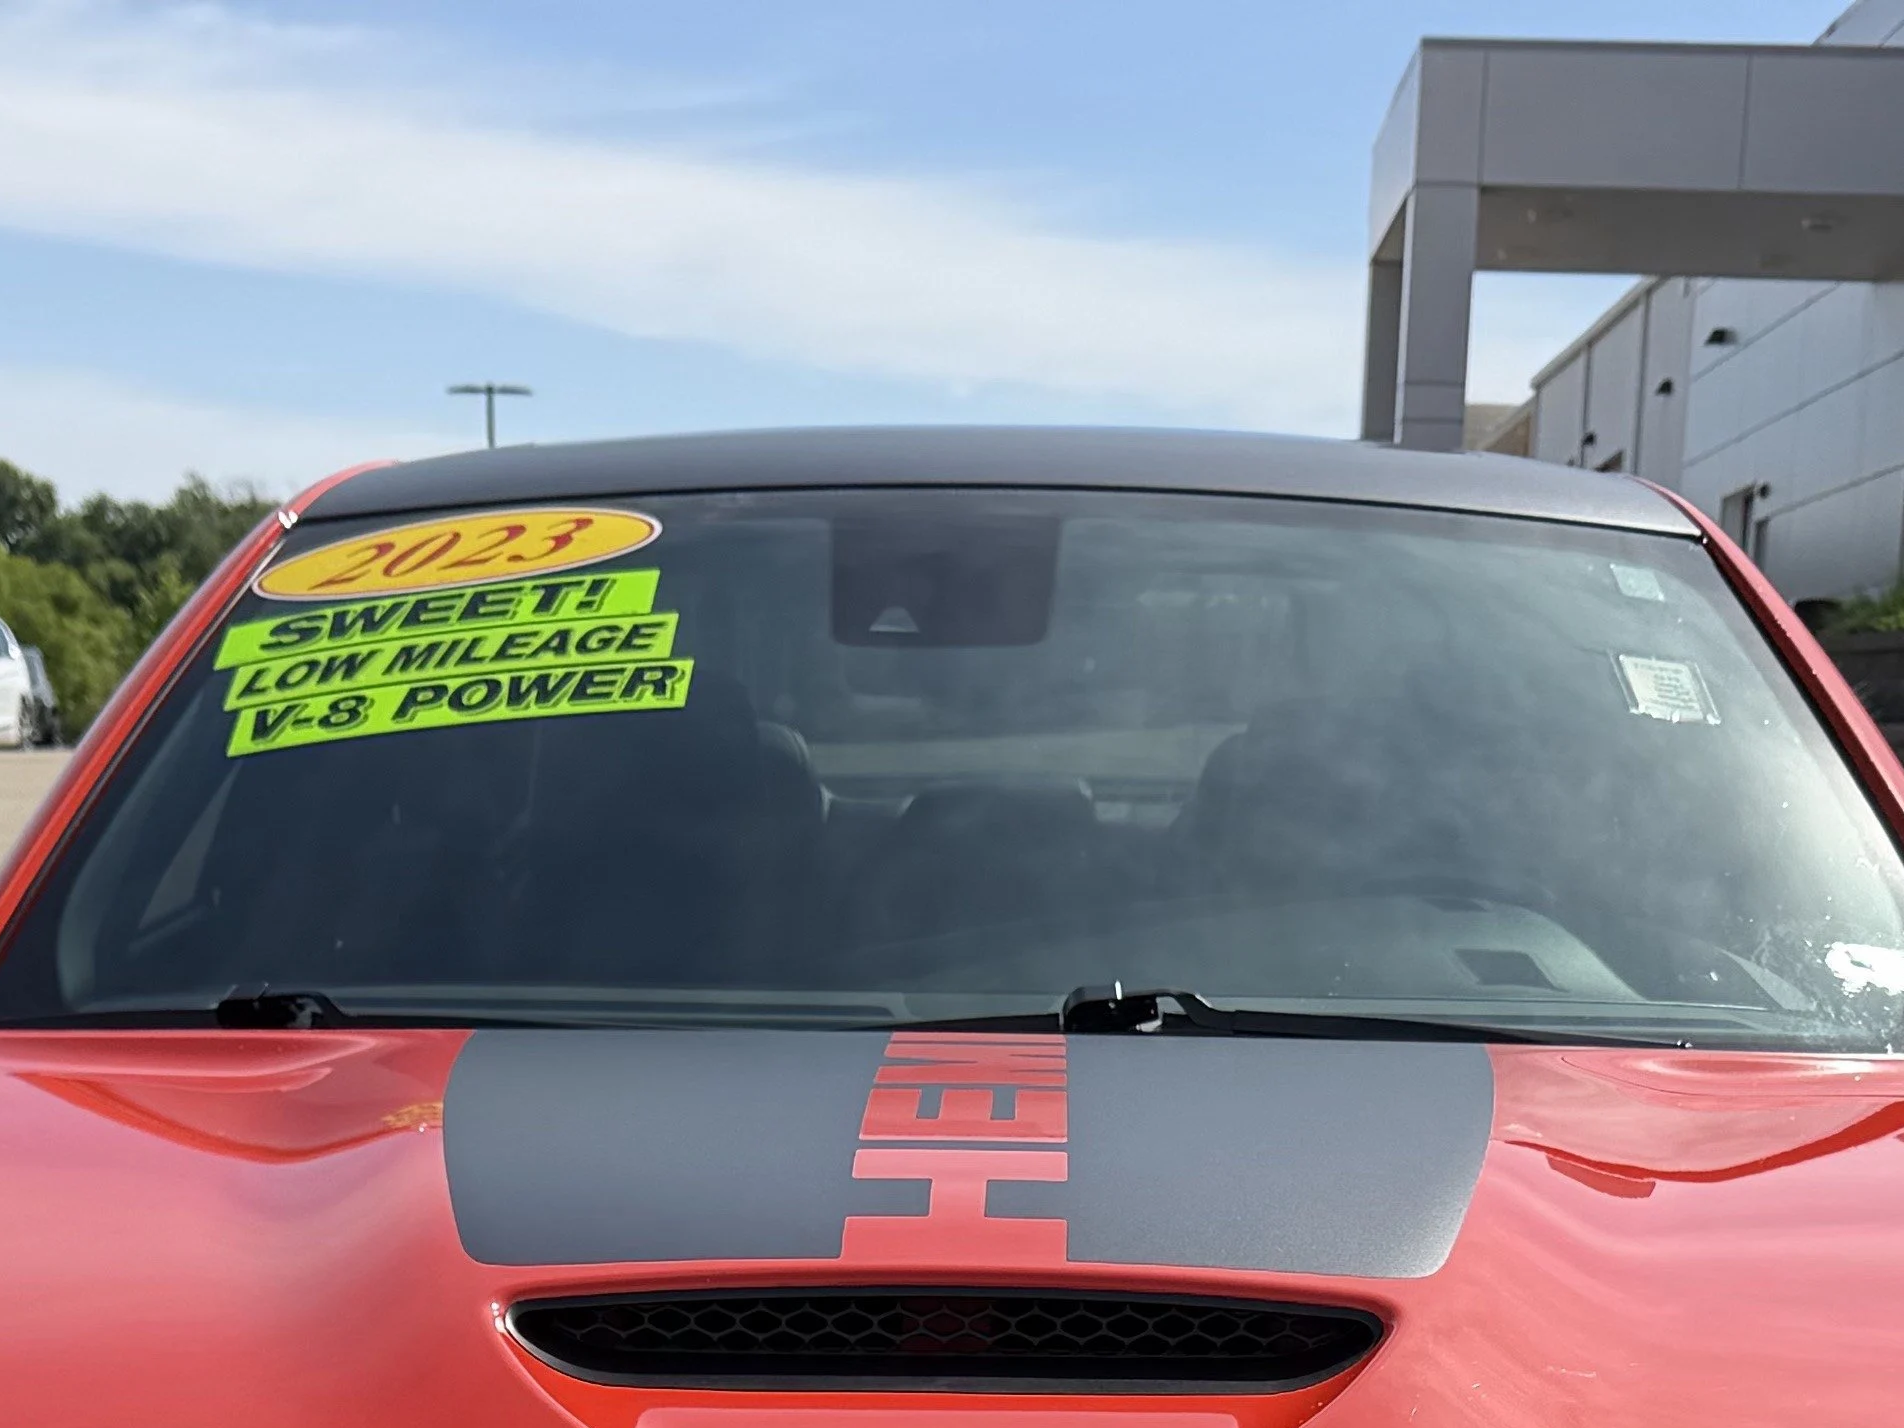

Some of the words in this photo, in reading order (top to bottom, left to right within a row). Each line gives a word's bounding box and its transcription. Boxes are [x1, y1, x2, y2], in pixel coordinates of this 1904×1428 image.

[307, 517, 595, 591] 2023
[259, 577, 618, 653] SWEET!
[236, 647, 382, 700] LOW
[381, 620, 669, 677] MILEAGE
[249, 694, 374, 745] V-8
[391, 664, 687, 723] POWER
